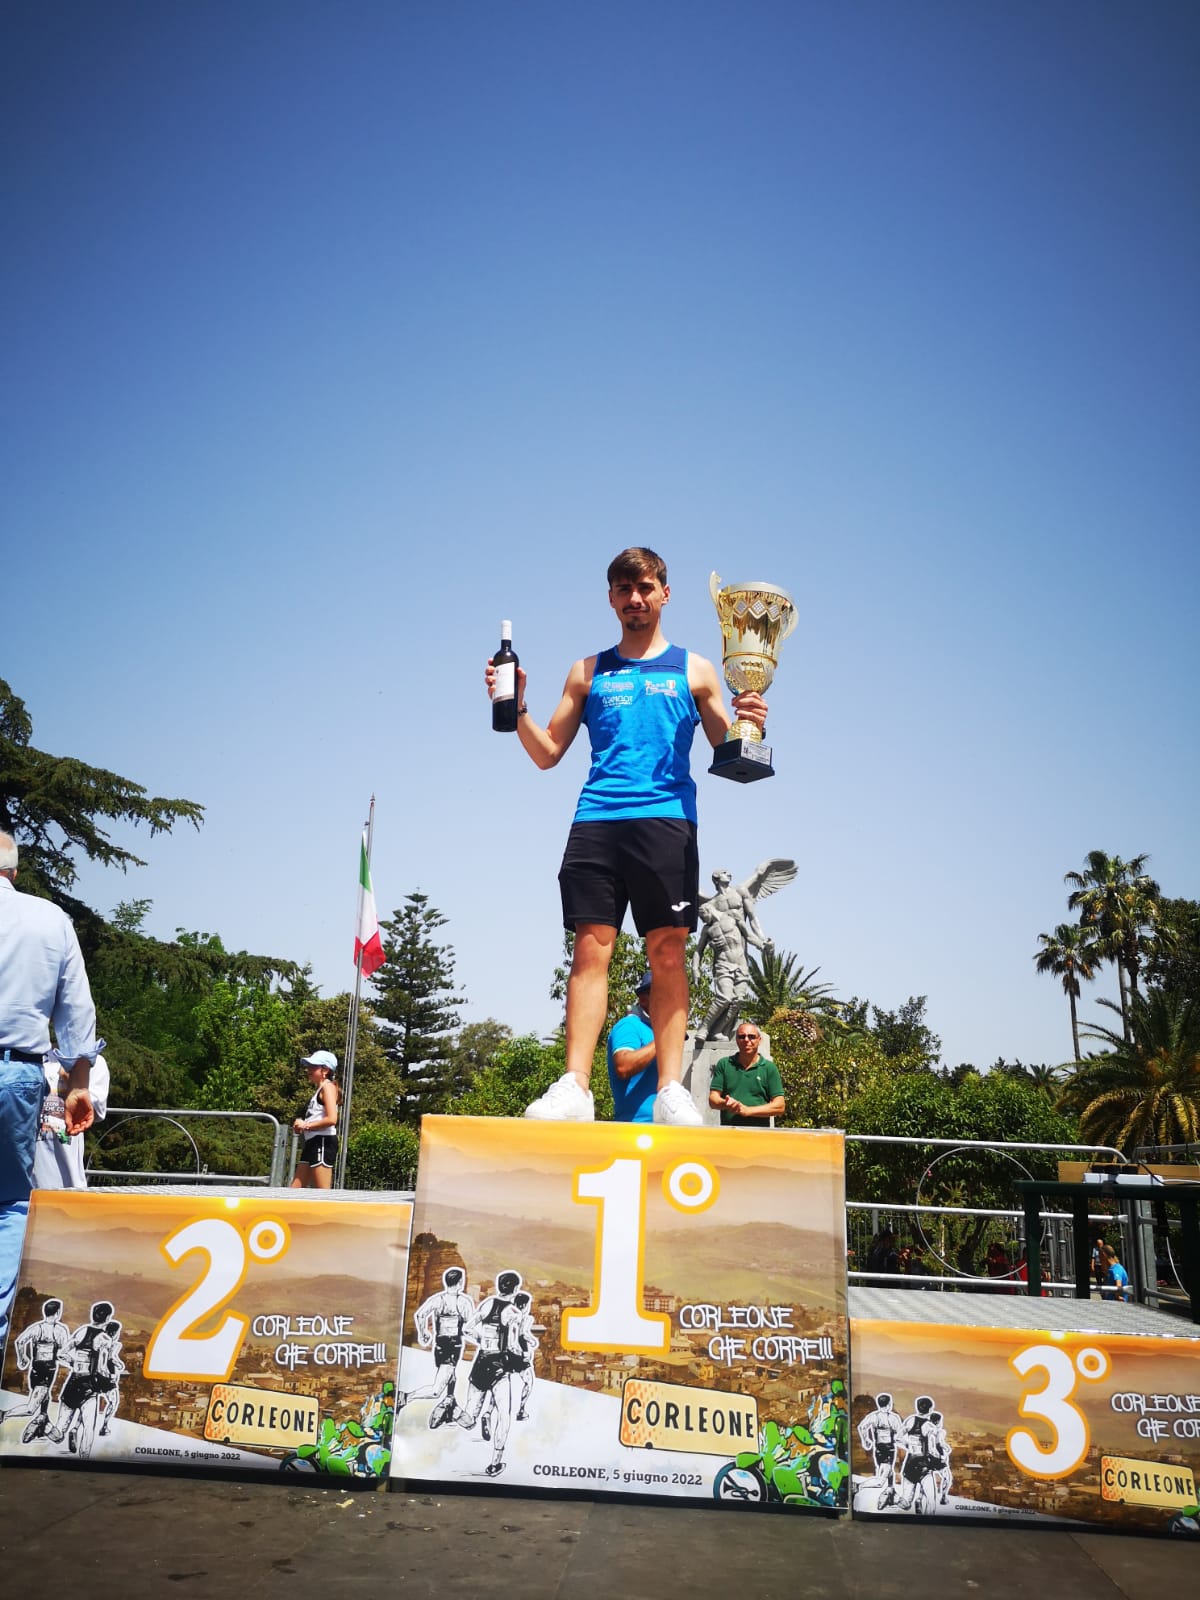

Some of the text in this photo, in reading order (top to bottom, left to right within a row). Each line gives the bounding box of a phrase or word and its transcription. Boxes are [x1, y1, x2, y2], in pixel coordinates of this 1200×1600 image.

[252, 1315, 354, 1340] CORLEONE
[679, 1304, 795, 1332] CORLEONE
[275, 1342, 387, 1371] CHE CORRE!!!
[708, 1334, 834, 1368] CHE CORRE!!!
[210, 1399, 316, 1434] CORLEONE
[626, 1398, 755, 1439] CORLEONE
[1111, 1393, 1200, 1416] CORLEONE
[1137, 1417, 1170, 1443] CHE
[135, 1446, 182, 1457] CORLEONE,
[190, 1450, 219, 1460] giugno
[221, 1452, 241, 1460] 2022
[533, 1464, 703, 1485] CORLEONE, 5 giugno 2022
[1104, 1468, 1194, 1496] CORLEONE
